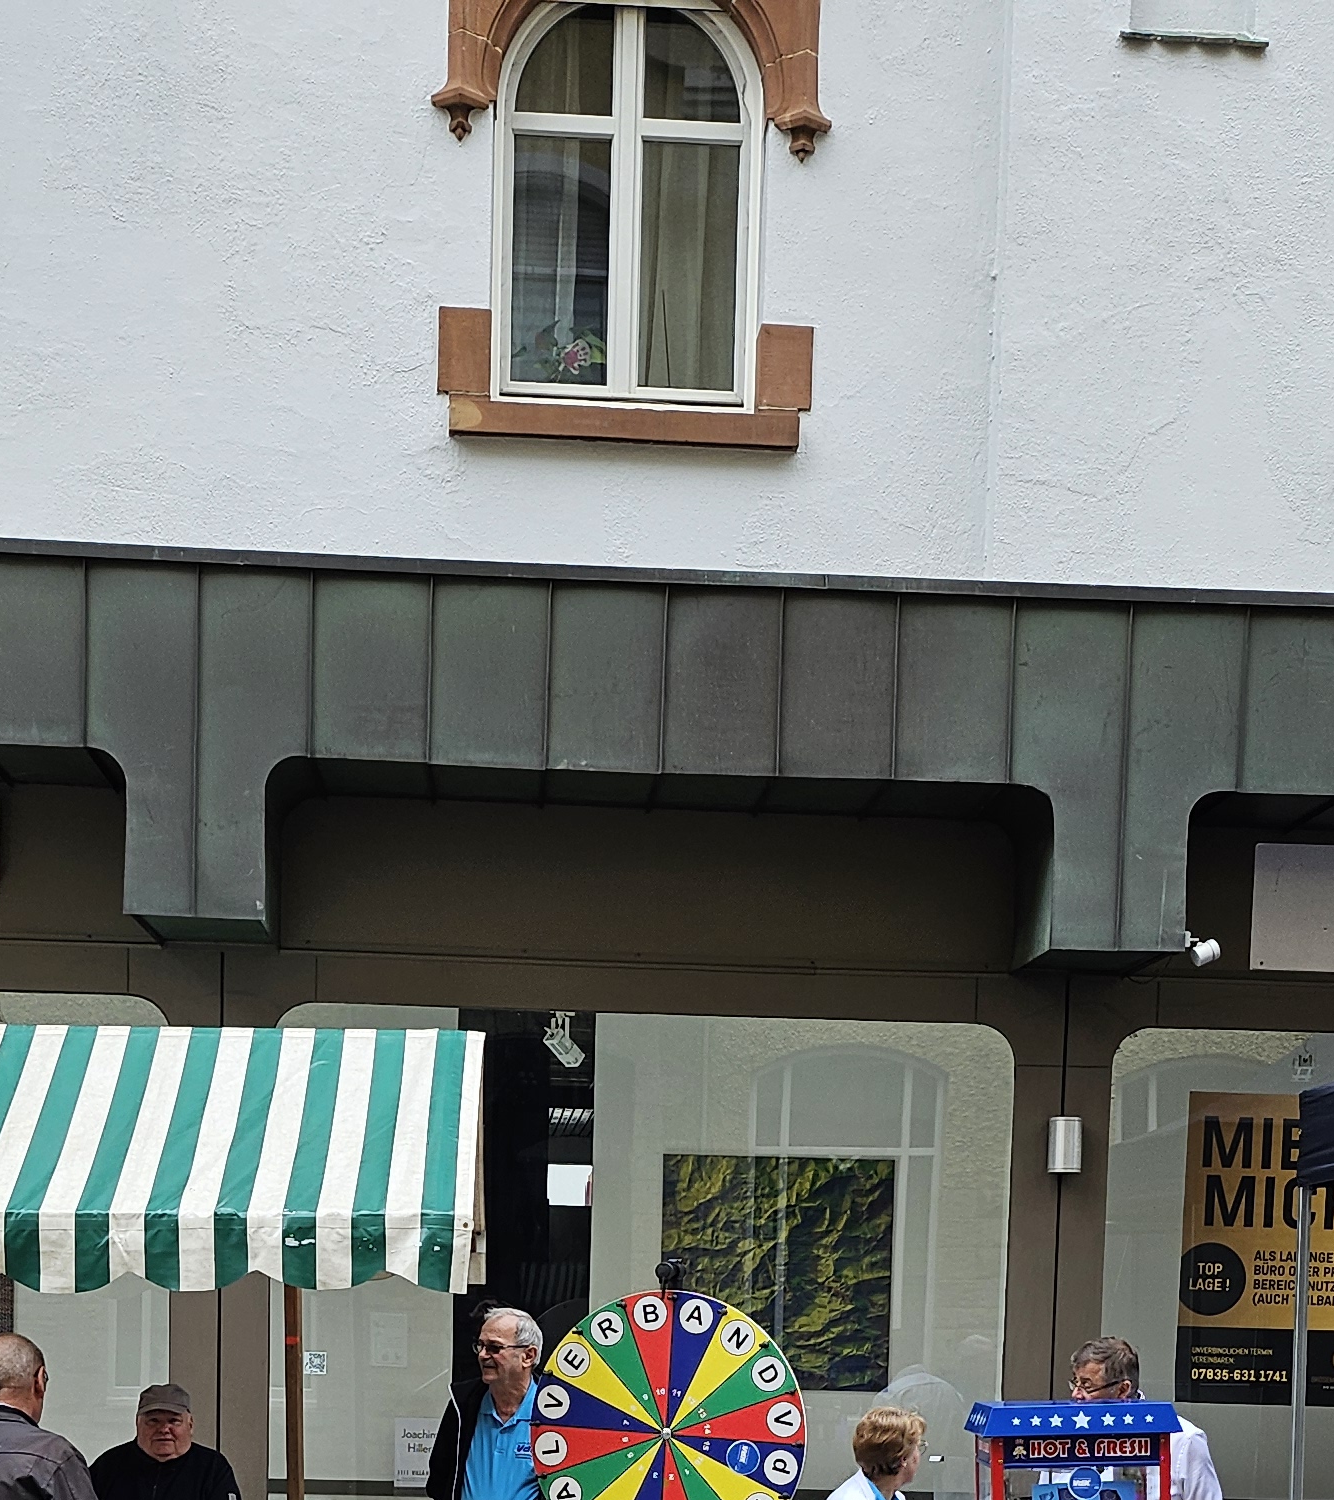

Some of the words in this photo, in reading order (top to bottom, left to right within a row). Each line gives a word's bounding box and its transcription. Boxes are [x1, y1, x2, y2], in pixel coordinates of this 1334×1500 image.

[1253, 1249, 1277, 1262] ALS
[1197, 1262, 1224, 1274] TOP
[1253, 1263, 1286, 1277] BÜRO
[1188, 1278, 1223, 1291] LAGE
[1251, 1292, 1290, 1306] (AUCH
[1191, 1368, 1256, 1381] 07835-631
[1258, 1370, 1288, 1382] 1741
[1029, 1439, 1071, 1459] HOT
[1075, 1438, 1090, 1458] &
[1094, 1437, 1151, 1457] FRESH
